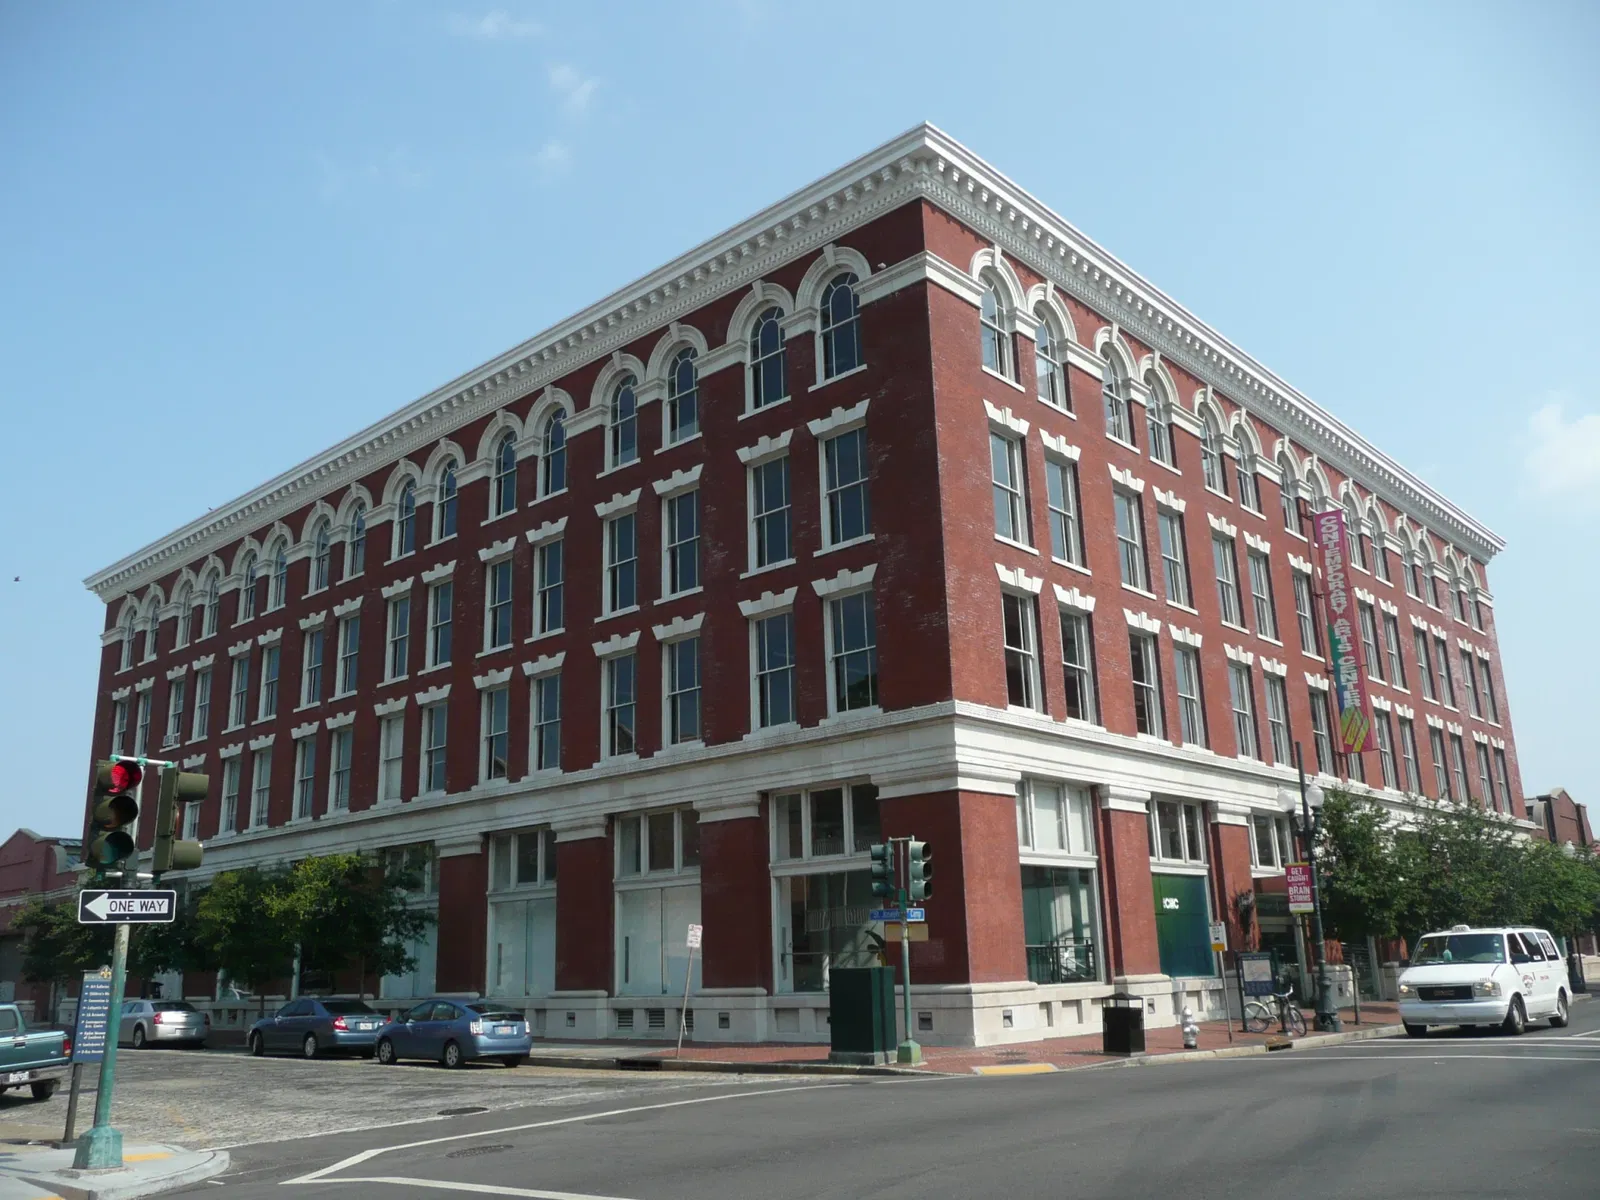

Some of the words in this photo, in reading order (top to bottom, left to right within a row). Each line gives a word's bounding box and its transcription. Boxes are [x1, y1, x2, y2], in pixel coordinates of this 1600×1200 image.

[1320, 516, 1347, 614] CONTEMPORARY
[1334, 618, 1352, 652] ARTS
[1338, 656, 1361, 707] CENTER
[1291, 867, 1303, 875] GET
[1288, 886, 1310, 895] BRAIN
[109, 900, 134, 912] ONE
[140, 900, 164, 912] WAY
